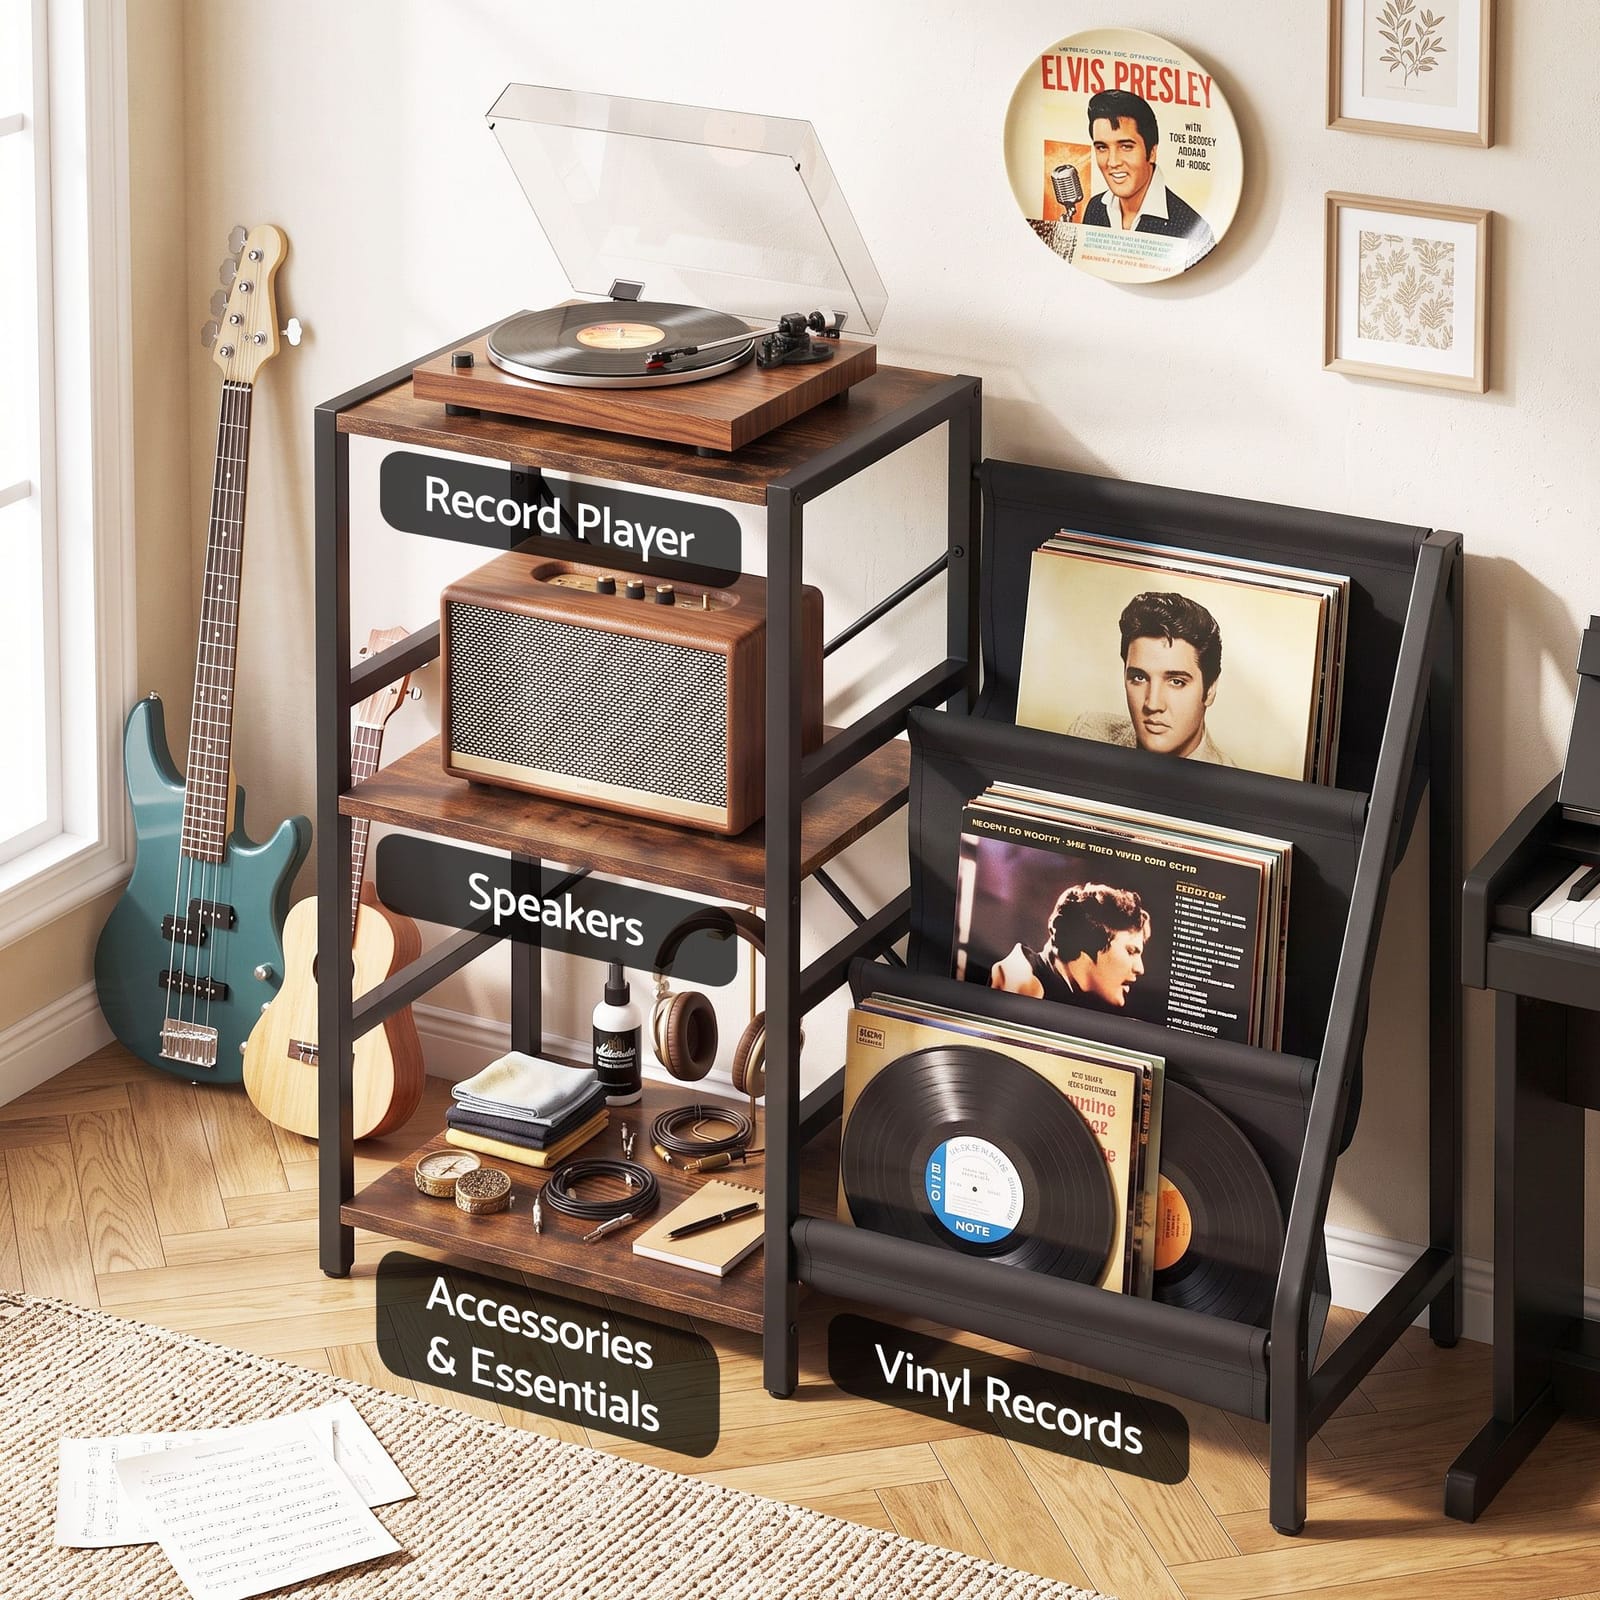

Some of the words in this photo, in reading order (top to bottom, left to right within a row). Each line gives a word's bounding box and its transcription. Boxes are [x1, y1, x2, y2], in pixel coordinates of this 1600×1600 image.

[1041, 55, 1105, 94] ELVIS
[1114, 60, 1213, 108] PRESLEY
[955, 1220, 990, 1237] NOTE
